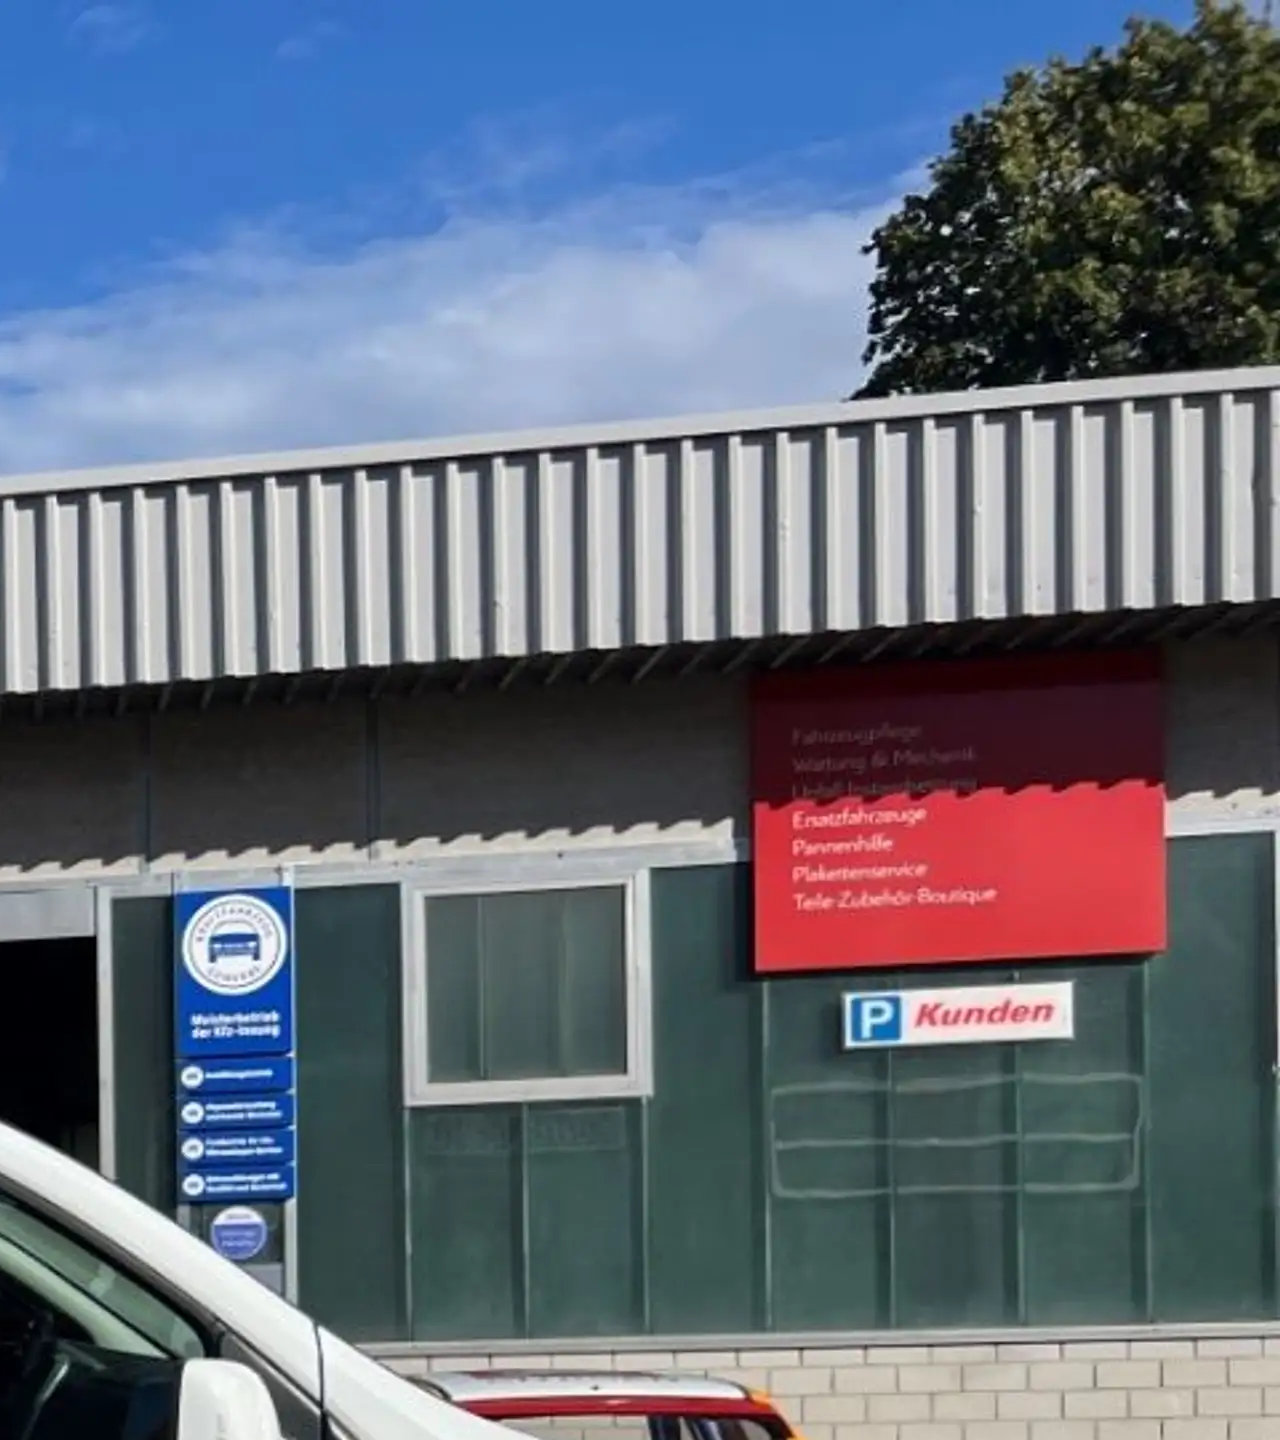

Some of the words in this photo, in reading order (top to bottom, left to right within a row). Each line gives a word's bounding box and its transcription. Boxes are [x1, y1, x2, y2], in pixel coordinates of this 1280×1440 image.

[791, 807, 928, 829] Ersatzfahrzeuge
[791, 833, 894, 856] Pannenhilfe
[791, 861, 928, 883] Plakettenservice
[860, 1000, 894, 1040] P
[915, 999, 1054, 1028] Kunden
